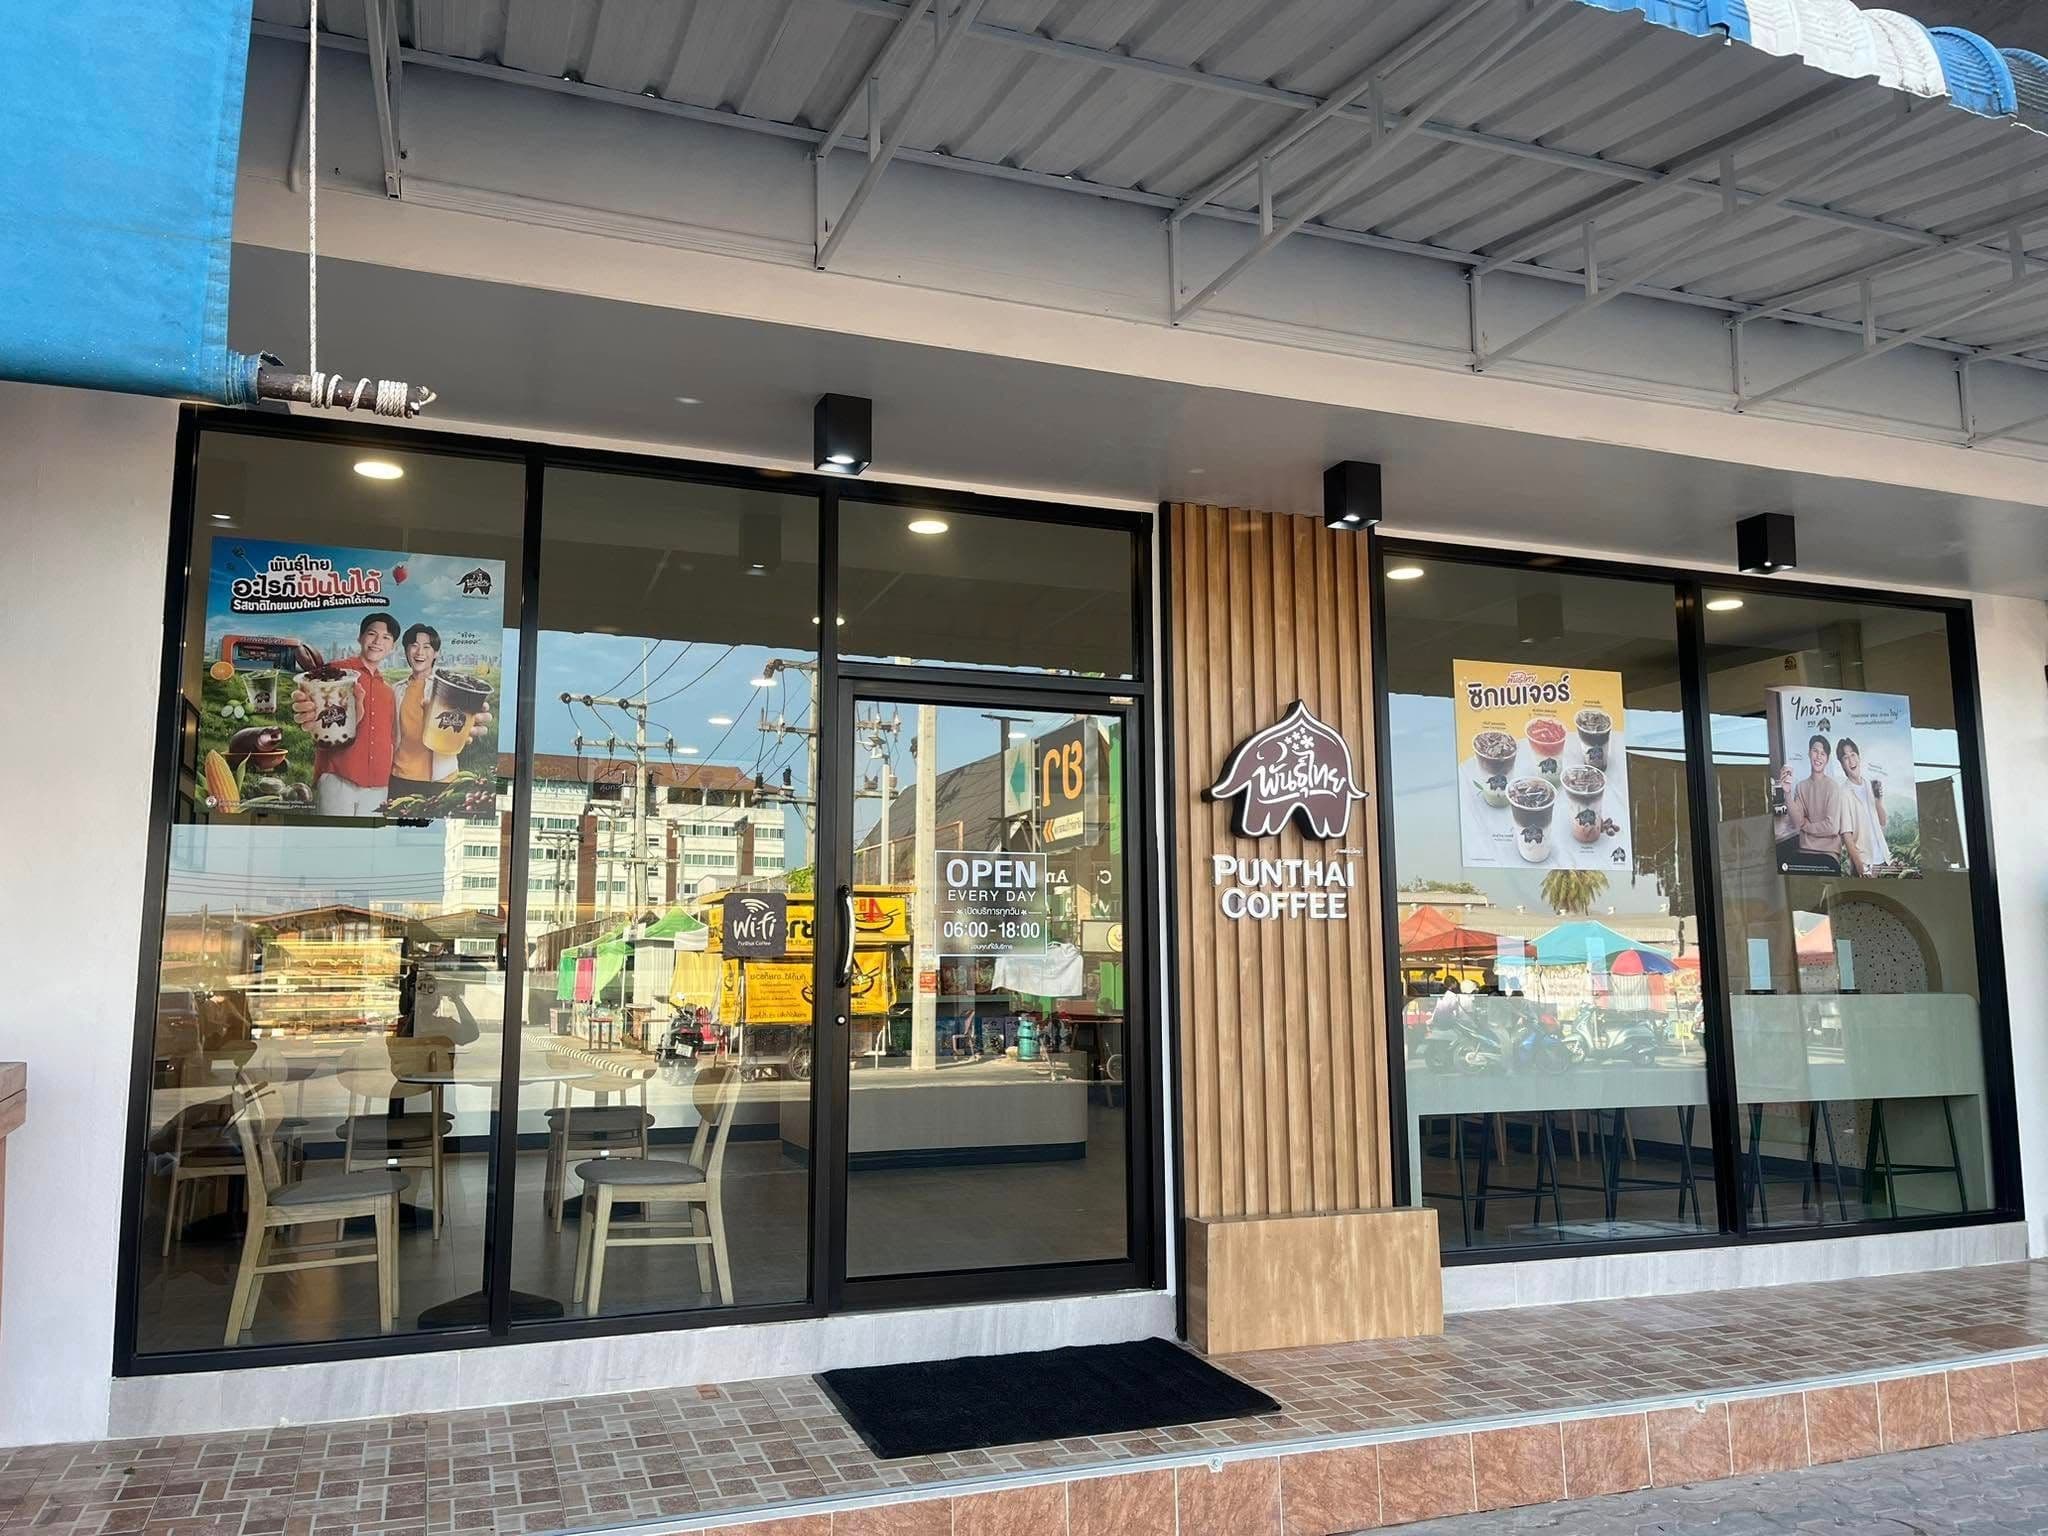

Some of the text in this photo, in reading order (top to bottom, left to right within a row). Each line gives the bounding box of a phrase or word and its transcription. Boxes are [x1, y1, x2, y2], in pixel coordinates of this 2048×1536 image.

[270, 555, 330, 573] พันธุ์ไทย
[233, 569, 381, 597] อะไรก็เป็นไปได้
[1468, 675, 1570, 708] ซิกเนเจอร์
[1252, 749, 1346, 799] พันธุ์ไทย
[946, 858, 1037, 888] OPEN
[1212, 853, 1355, 887] PUNTHAI
[948, 890, 1037, 902] EVERY DAY
[1221, 886, 1347, 919] COFFEE
[965, 906, 1020, 917] เปิดบริการทุกวัน
